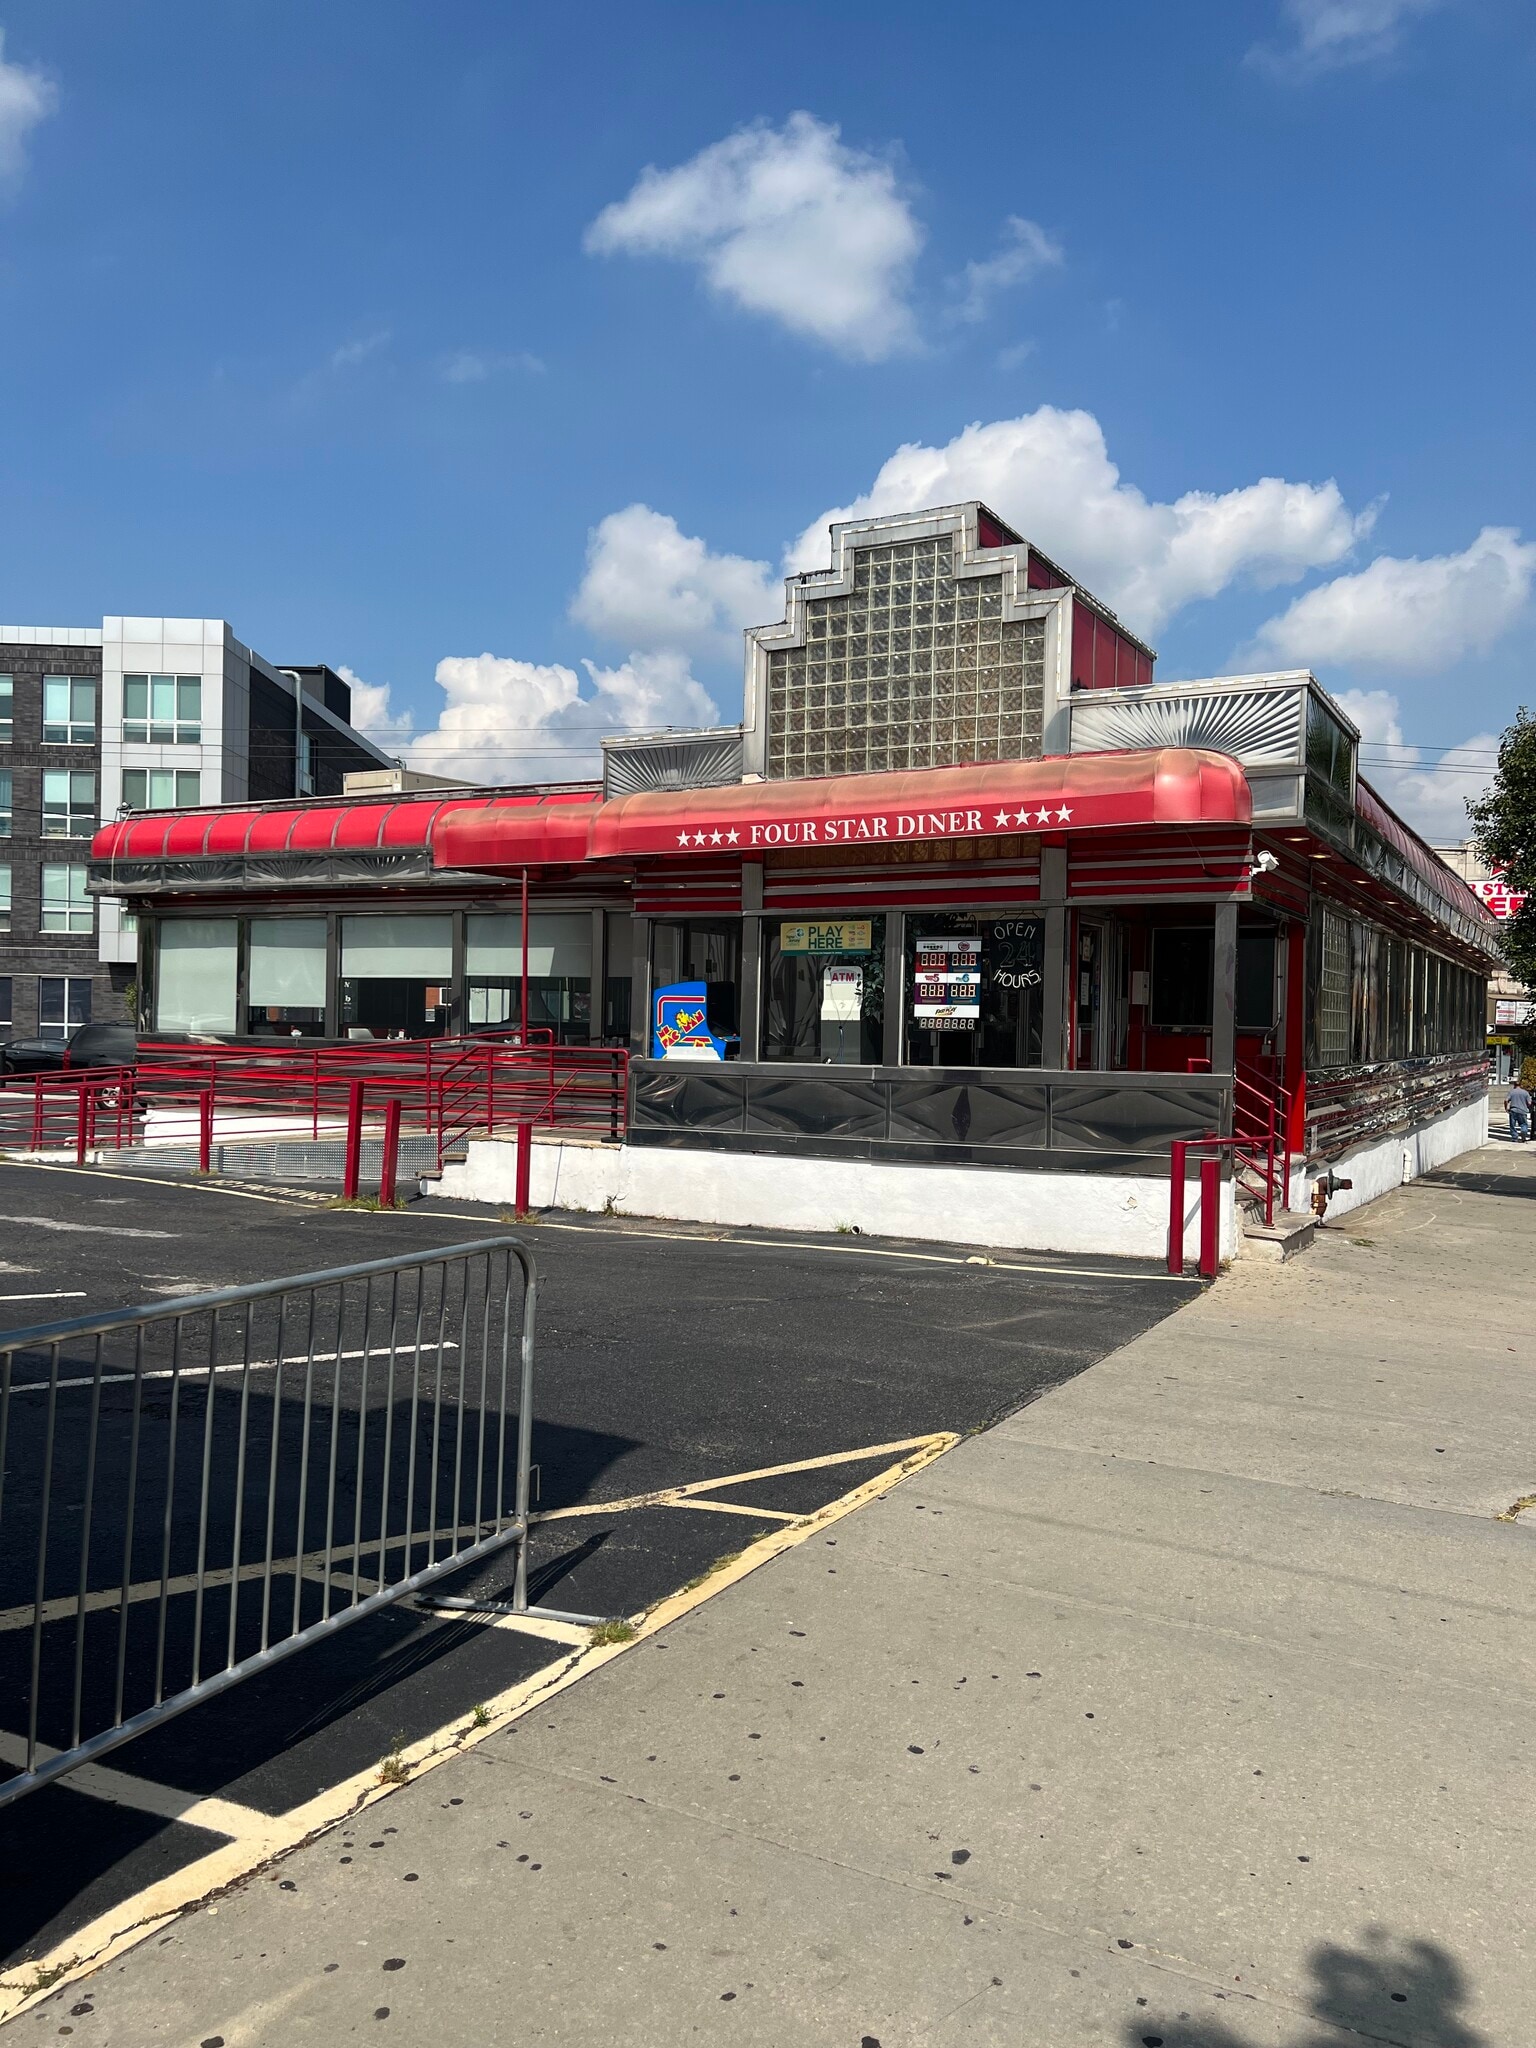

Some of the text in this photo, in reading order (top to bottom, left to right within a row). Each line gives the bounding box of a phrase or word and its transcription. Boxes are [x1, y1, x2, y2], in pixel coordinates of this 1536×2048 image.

[750, 810, 984, 844] FOUR STAR DINER
[808, 925, 844, 937] PLAY
[994, 922, 1037, 939] OPEN
[808, 938, 843, 949] HERE
[999, 941, 1035, 968] 24
[832, 973, 854, 982] ATM
[993, 969, 1040, 989] HOURS
